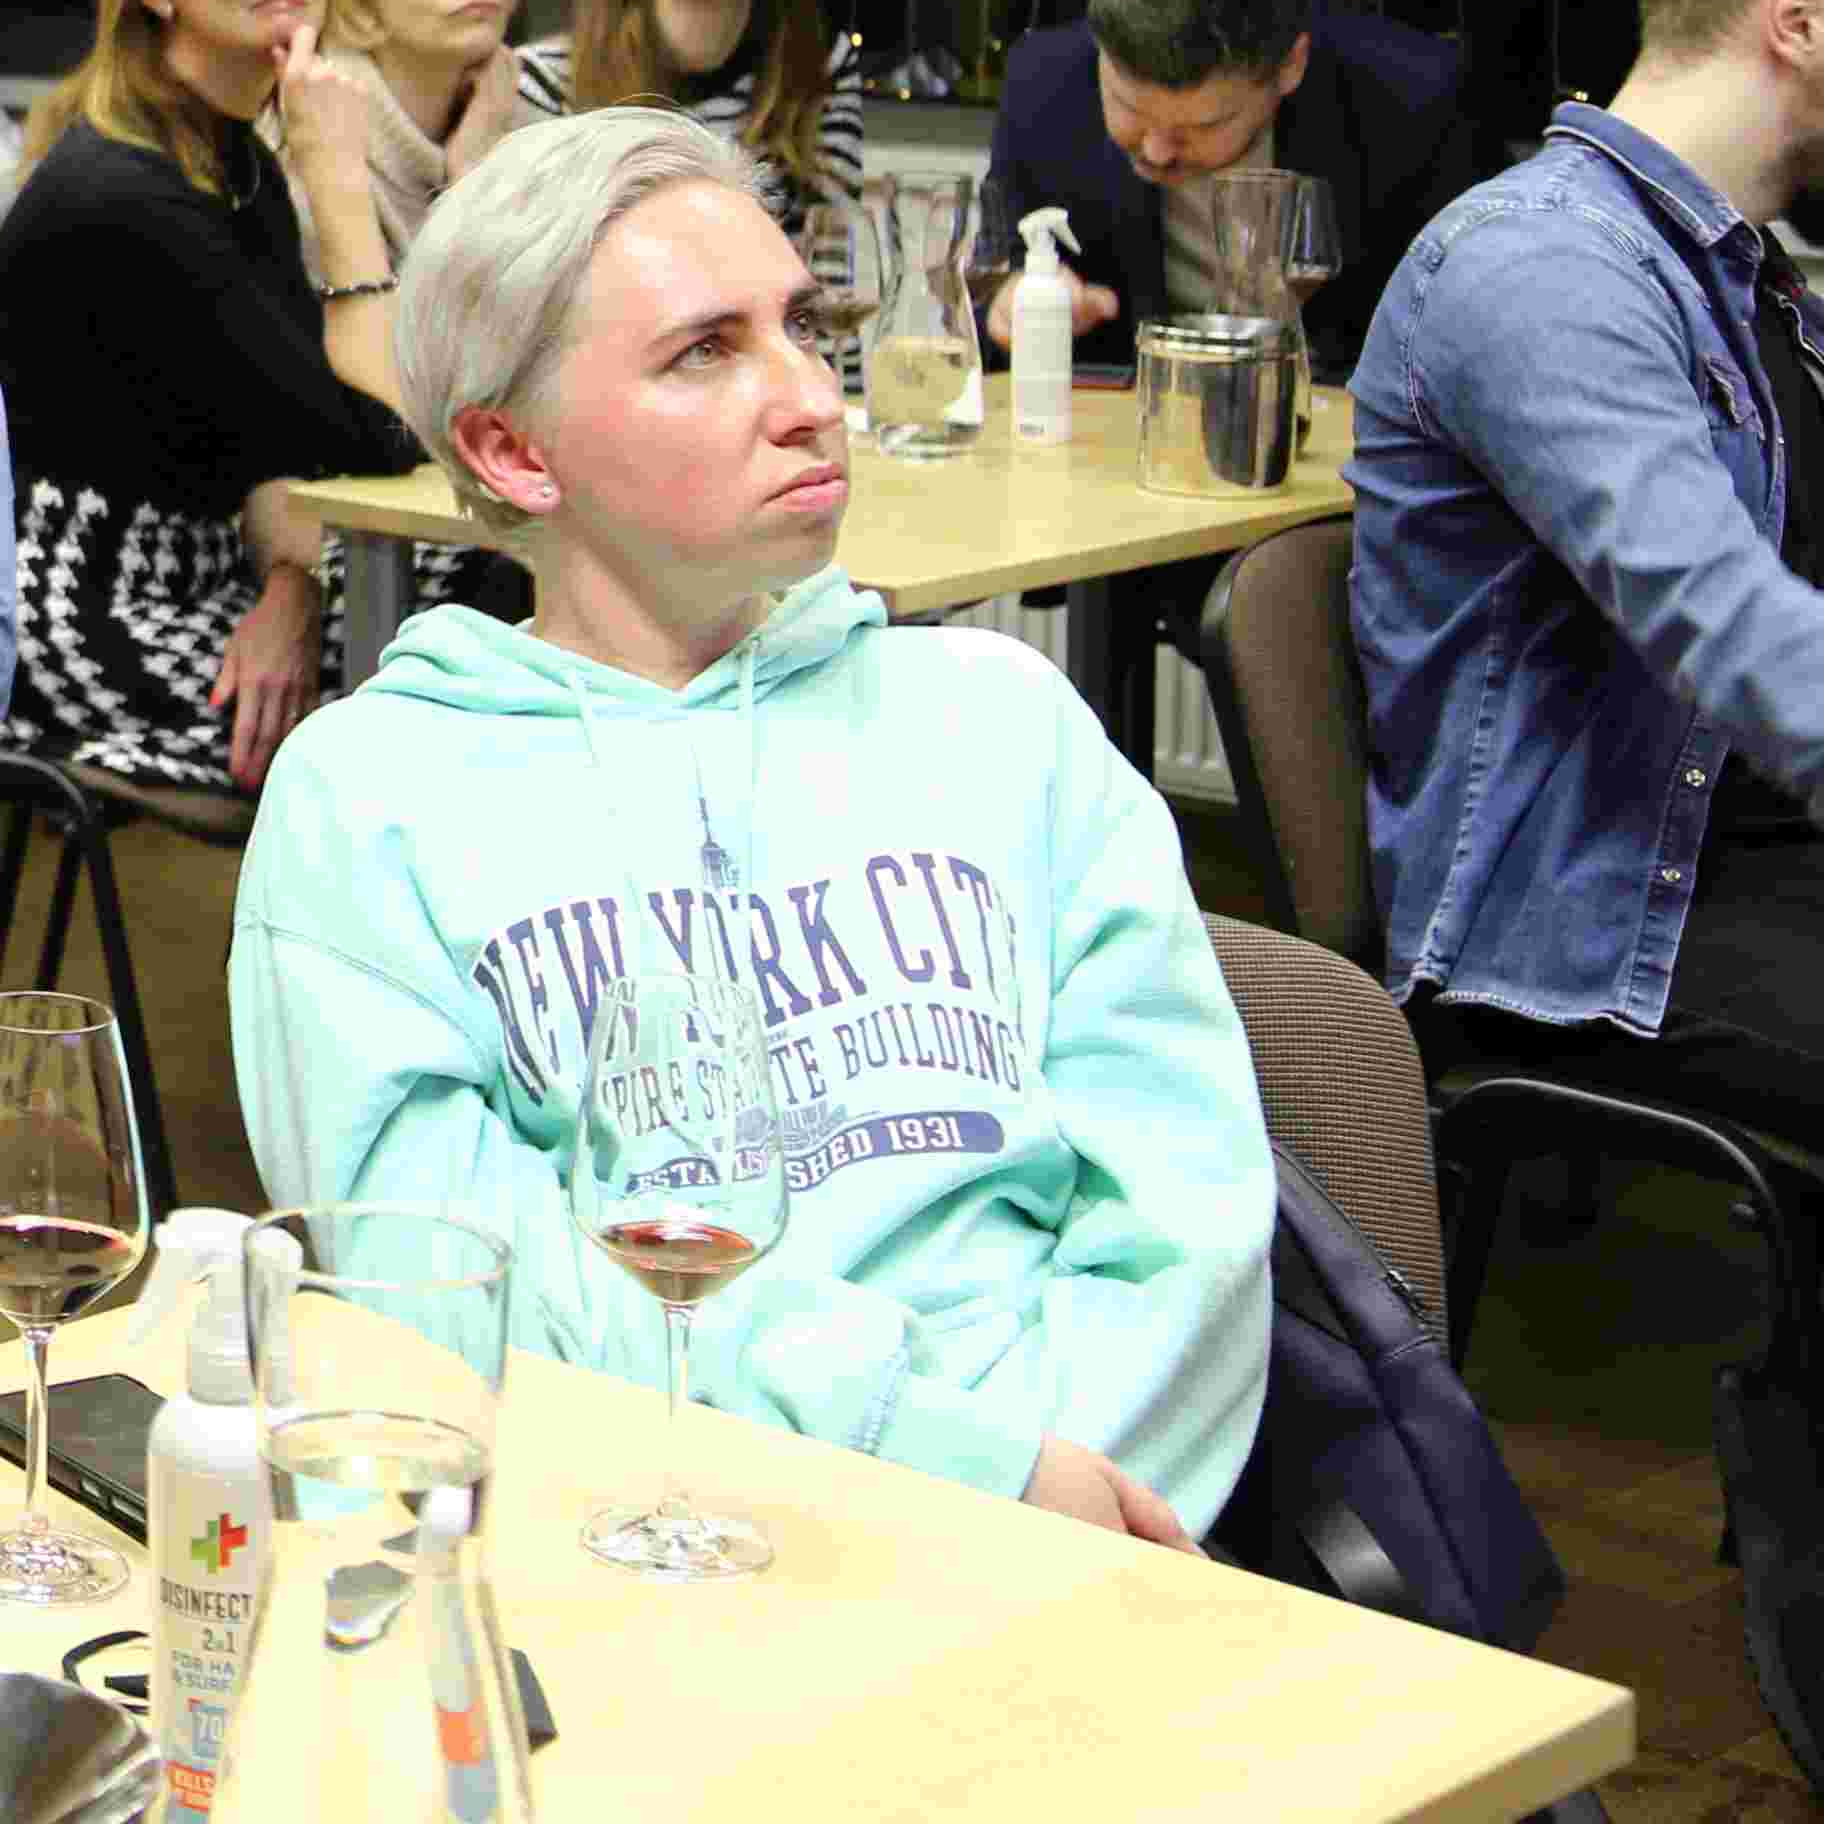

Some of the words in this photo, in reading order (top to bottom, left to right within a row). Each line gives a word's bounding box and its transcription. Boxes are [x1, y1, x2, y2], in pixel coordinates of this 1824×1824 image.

[473, 896, 639, 1107] NEW
[833, 1002, 1021, 1093] BUILDING
[883, 1115, 965, 1153] 1931
[159, 1577, 253, 1619] DISINFECT
